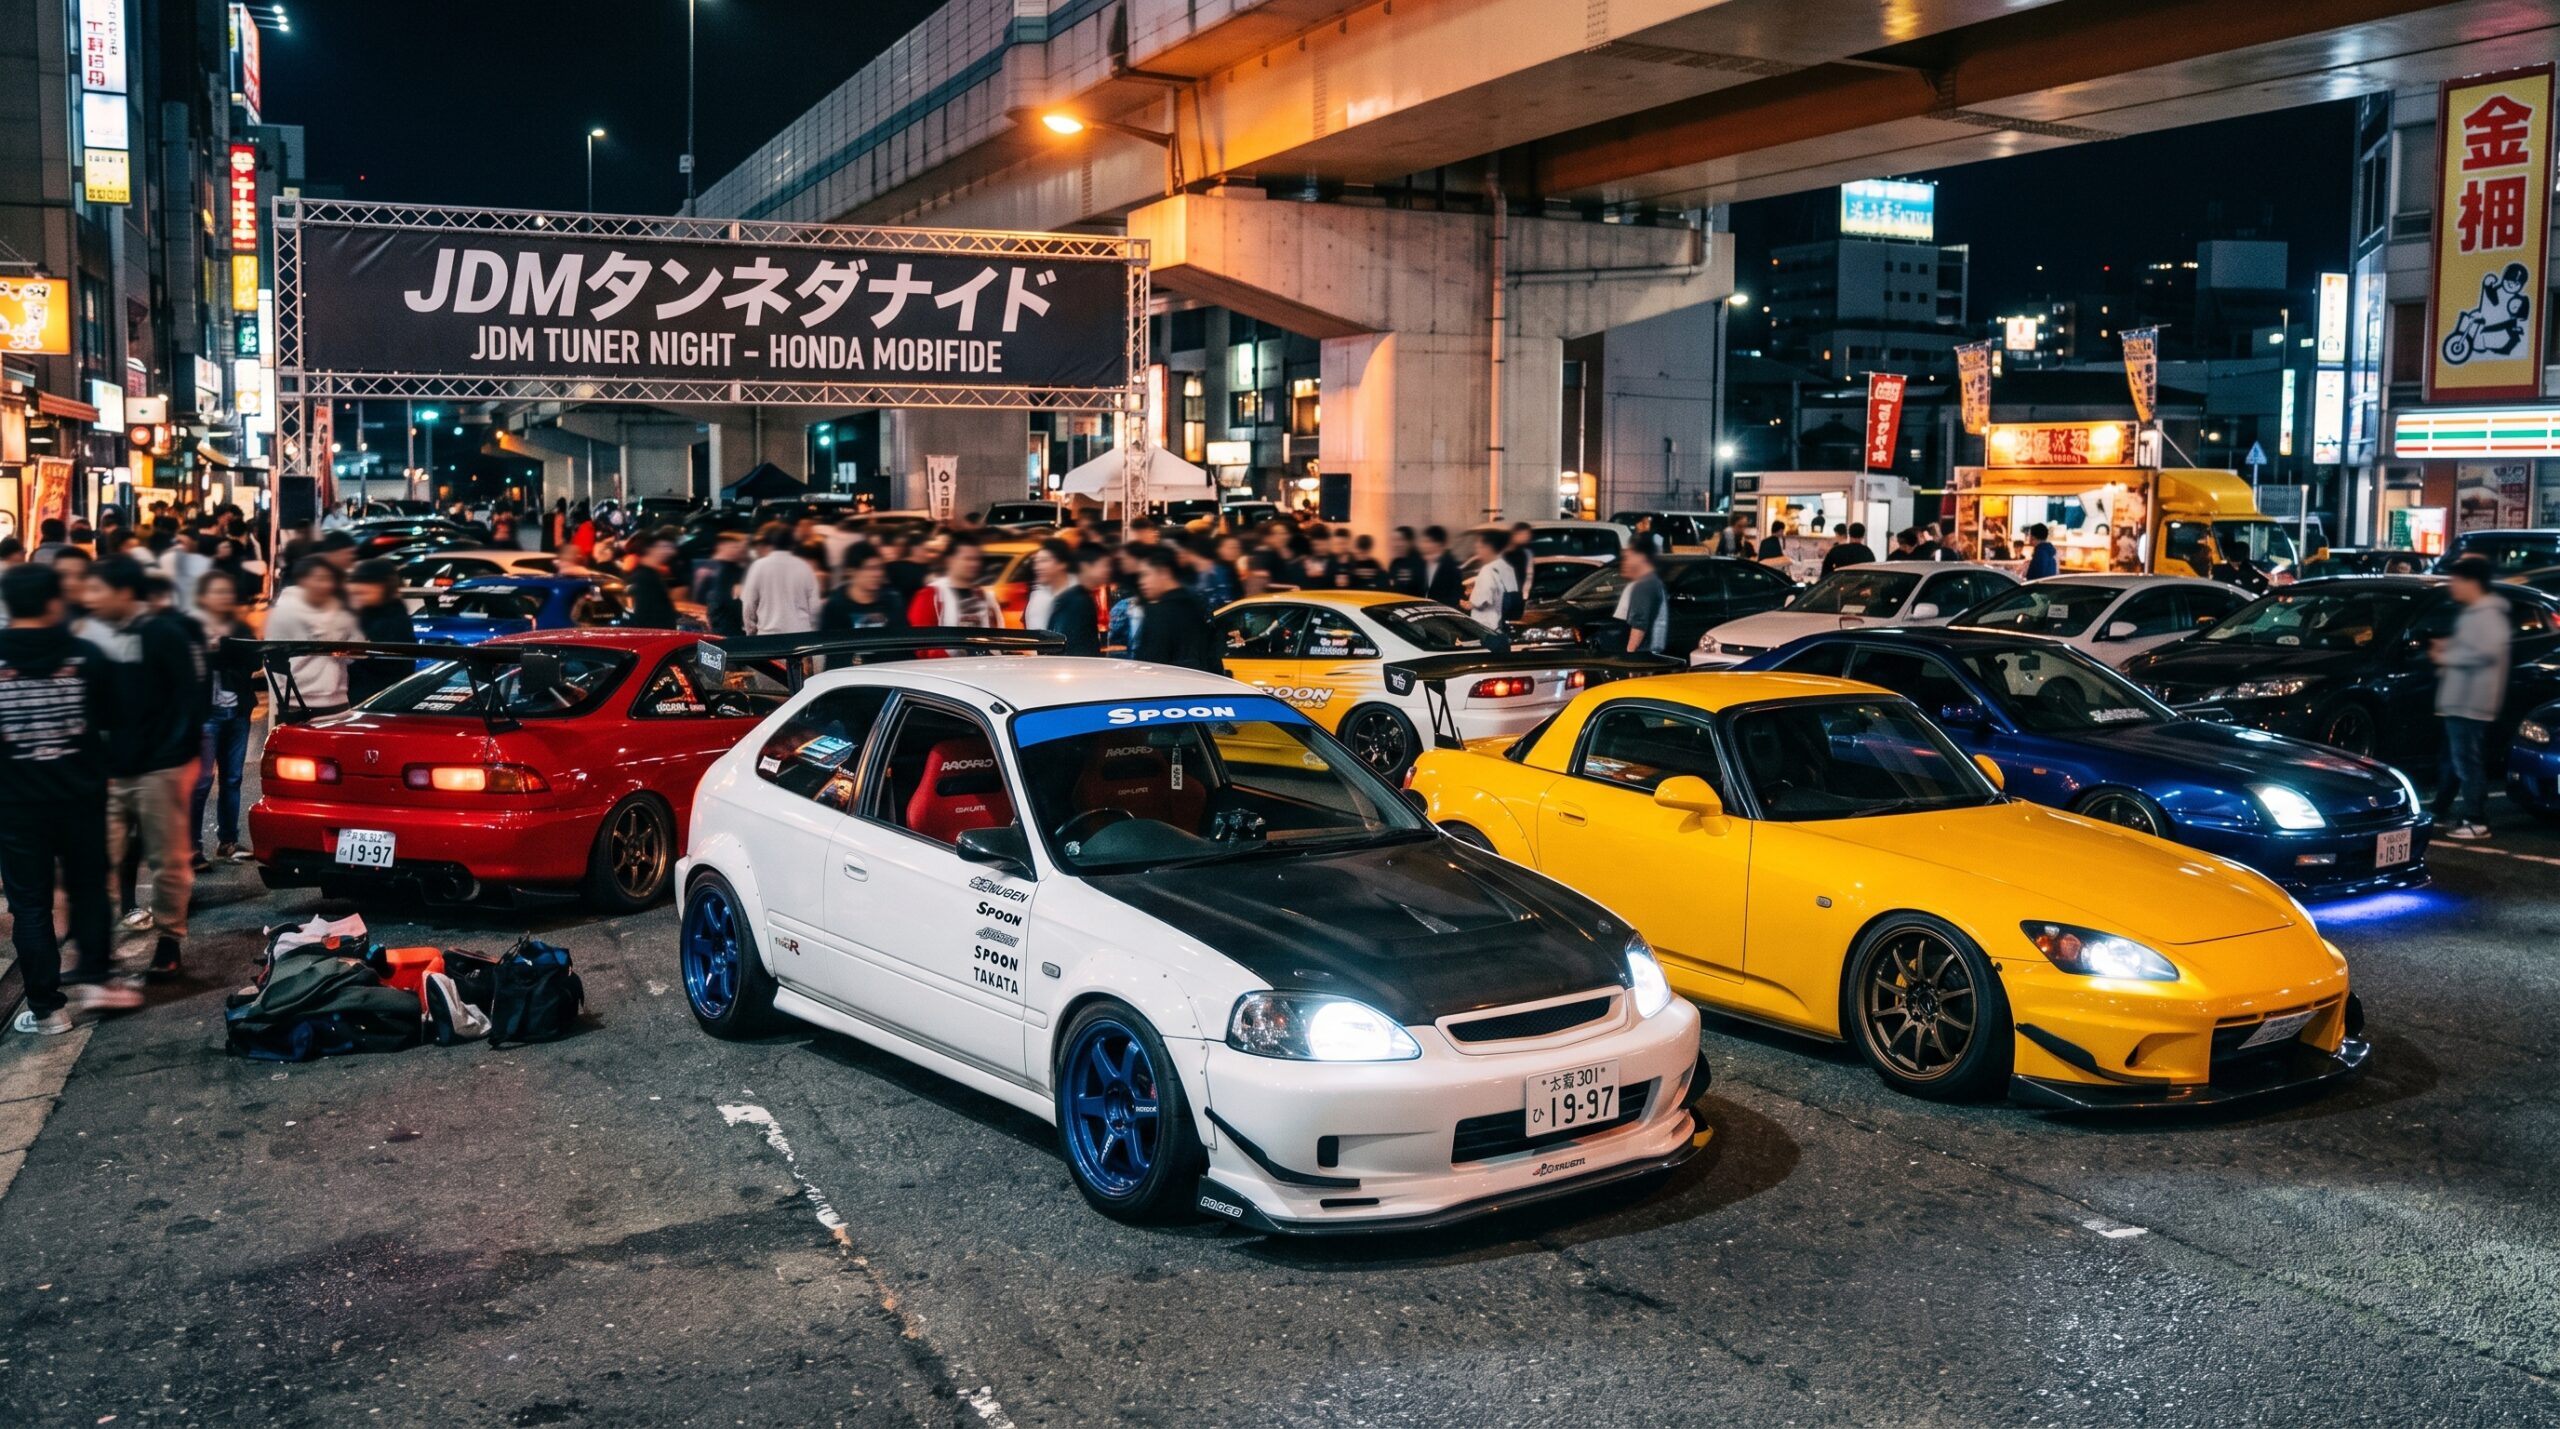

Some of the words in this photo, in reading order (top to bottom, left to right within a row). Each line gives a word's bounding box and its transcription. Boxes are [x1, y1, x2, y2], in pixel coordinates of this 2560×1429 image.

[404, 248, 1057, 332] JDMタンネダナイド
[470, 325, 534, 362] JDM
[543, 328, 640, 364] TUNER
[650, 331, 736, 367] NIGHT
[770, 334, 864, 370] HONDA
[873, 337, 1002, 373] MOBIFIDE
[349, 843, 391, 864] 19-97
[974, 945, 1018, 971] SPOON
[974, 966, 1018, 995] TAKATA
[1577, 1067, 1598, 1087] 301
[1551, 1085, 1614, 1127] 19-97
